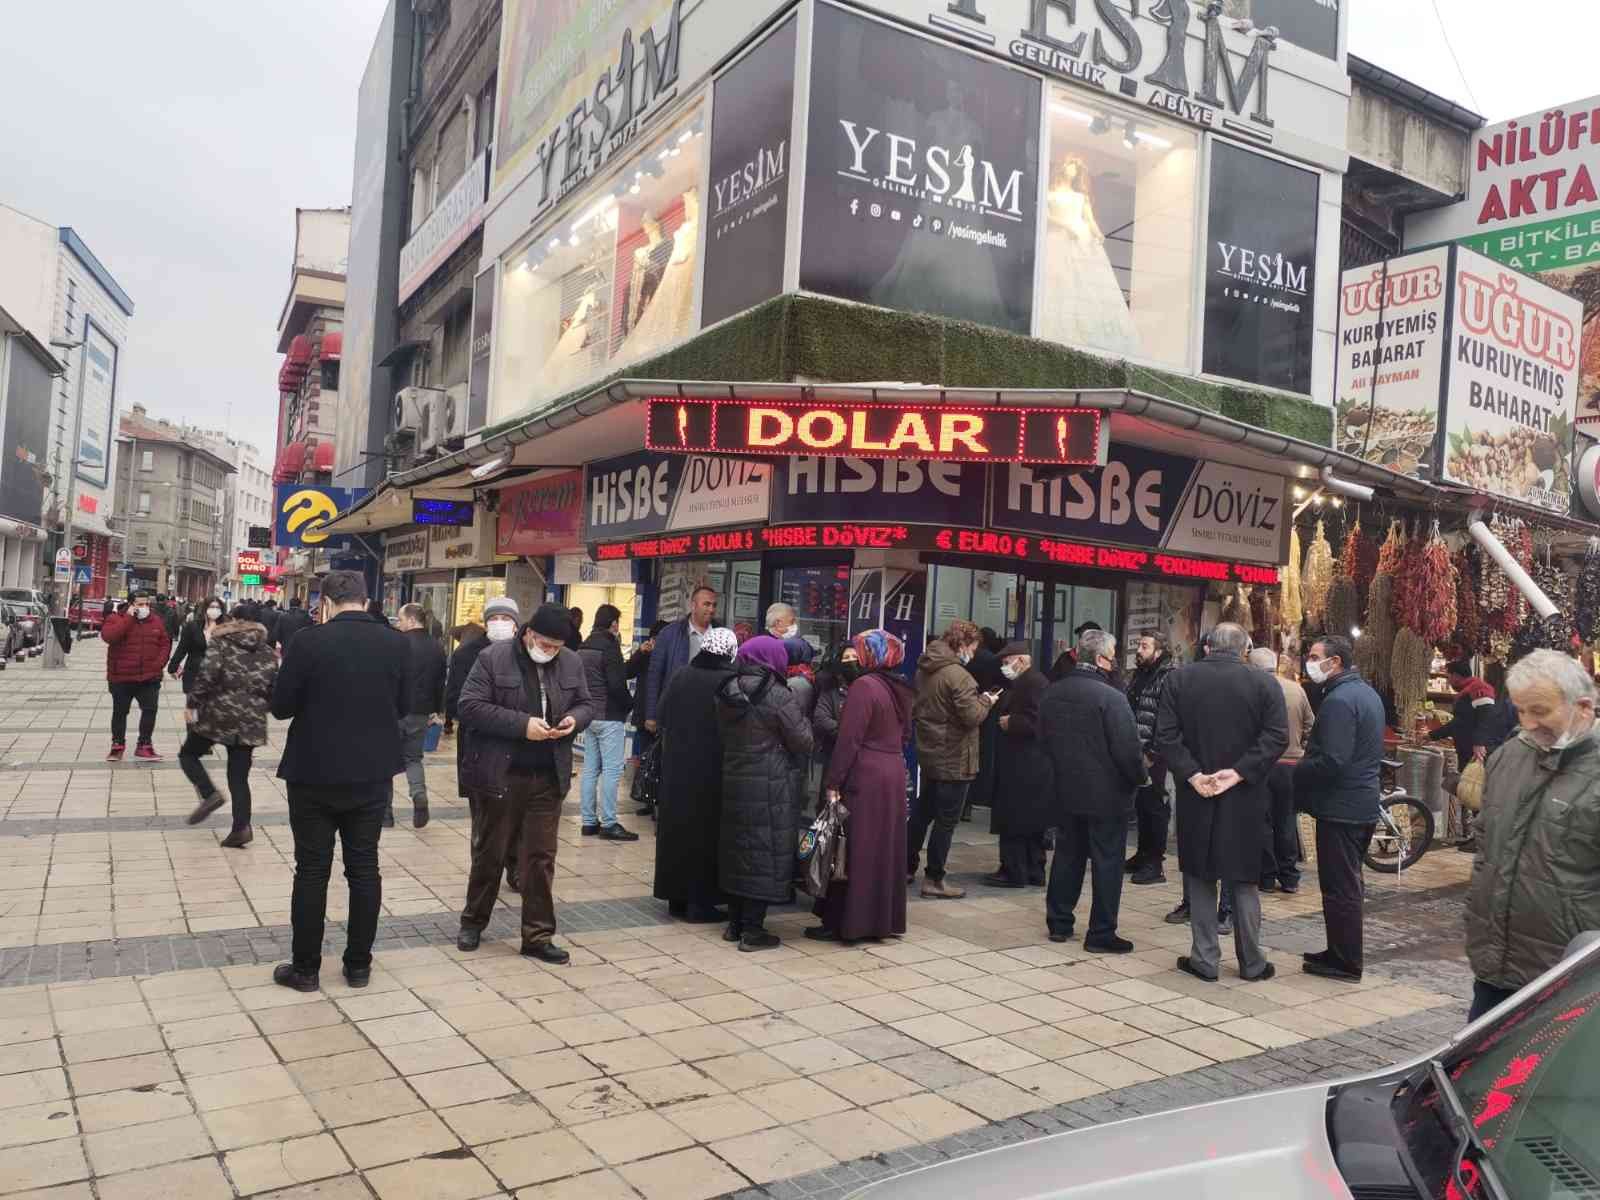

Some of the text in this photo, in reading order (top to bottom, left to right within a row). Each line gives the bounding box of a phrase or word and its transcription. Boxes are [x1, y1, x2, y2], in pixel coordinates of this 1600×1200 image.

[1477, 163, 1599, 225] AKTA
[1343, 265, 1442, 316] UĞUR
[1458, 271, 1576, 371] UĞUR
[1458, 335, 1565, 406] KURUYEMİŞ
[747, 407, 989, 454] DOLAR
[1470, 381, 1552, 437] BAHARAT
[1193, 481, 1279, 531] DÖVİZ
[959, 531, 1012, 554] EURO
